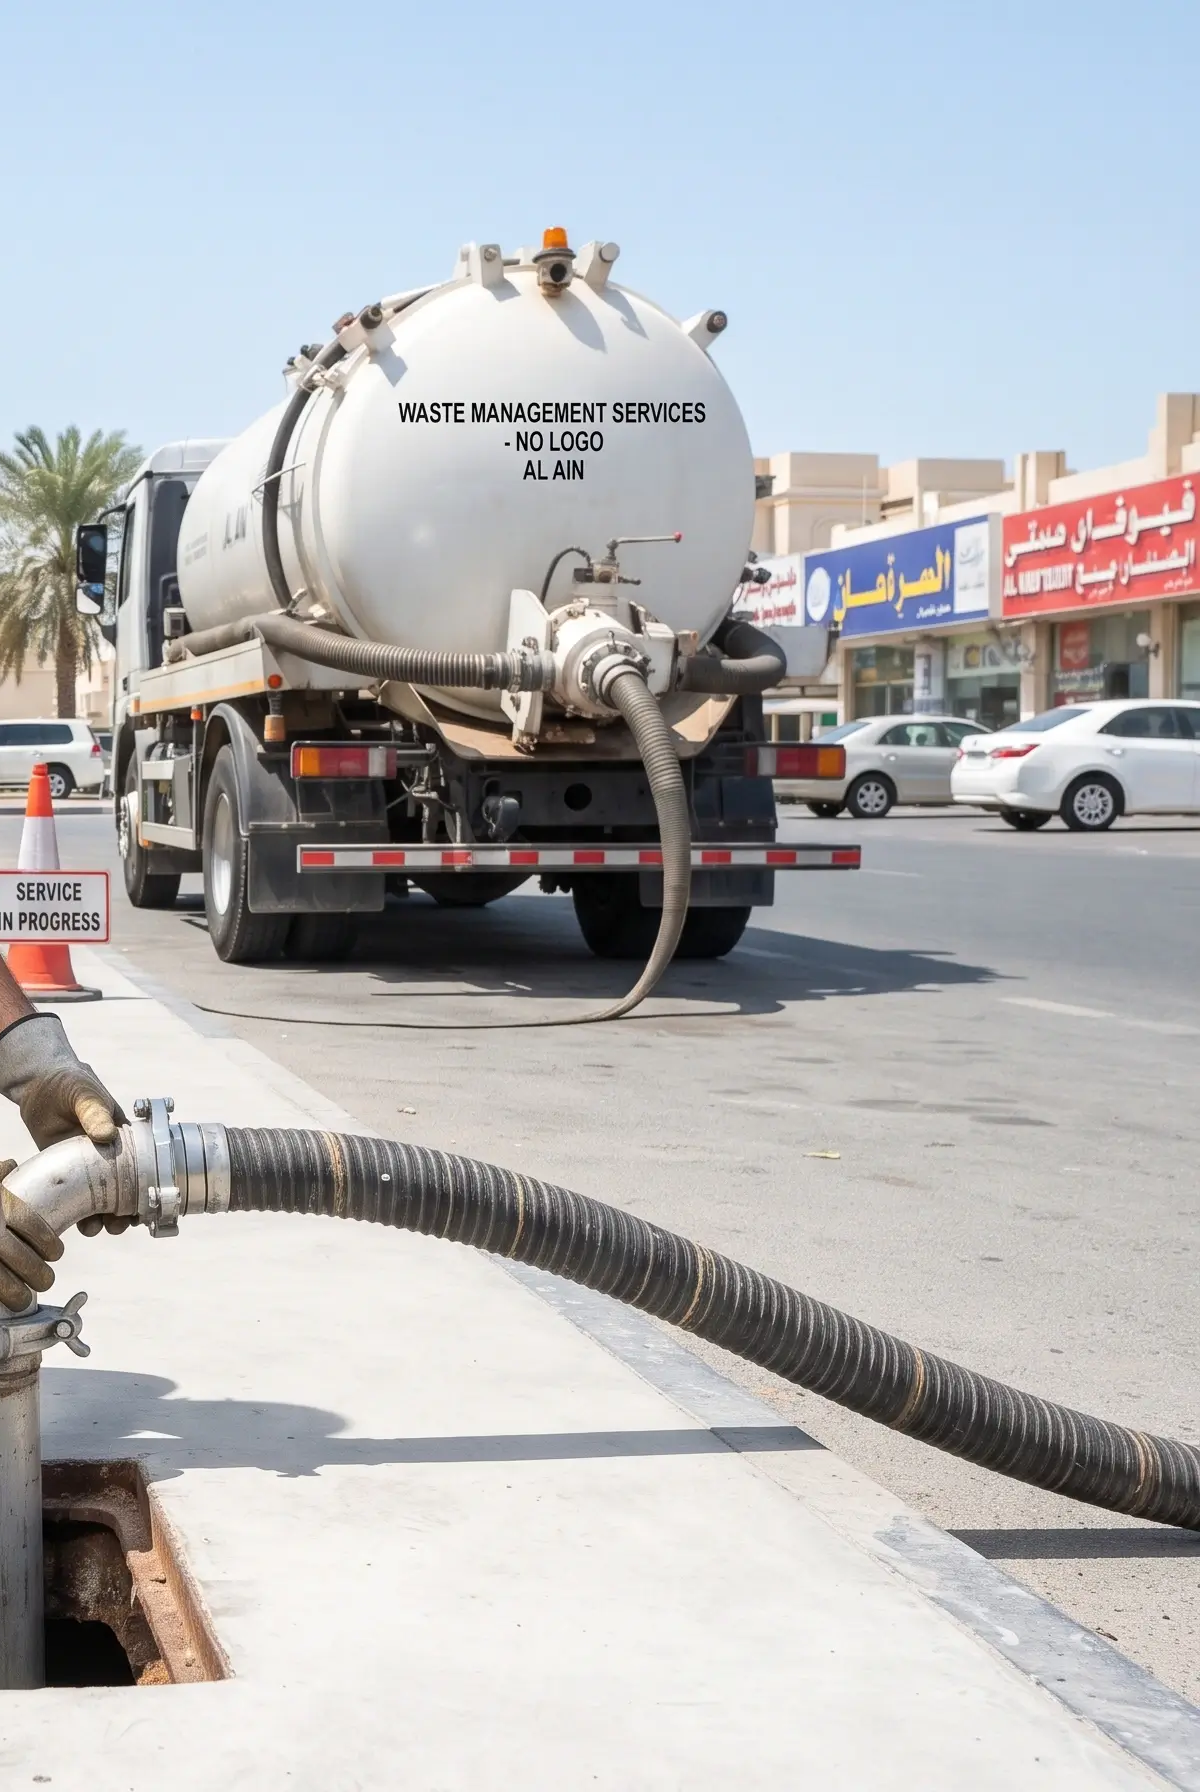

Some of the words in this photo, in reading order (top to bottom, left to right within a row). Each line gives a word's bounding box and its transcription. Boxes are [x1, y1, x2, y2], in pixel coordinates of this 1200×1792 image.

[398, 402, 465, 423] WASTE
[471, 402, 608, 423] MANAGEMENT
[612, 402, 706, 423] SERVICES
[516, 430, 544, 451] NO
[549, 430, 604, 451] LOGO
[522, 459, 549, 480] AL
[552, 459, 584, 480] AIN
[16, 882, 82, 901] SERVICE
[18, 911, 101, 931] PROGRESS
